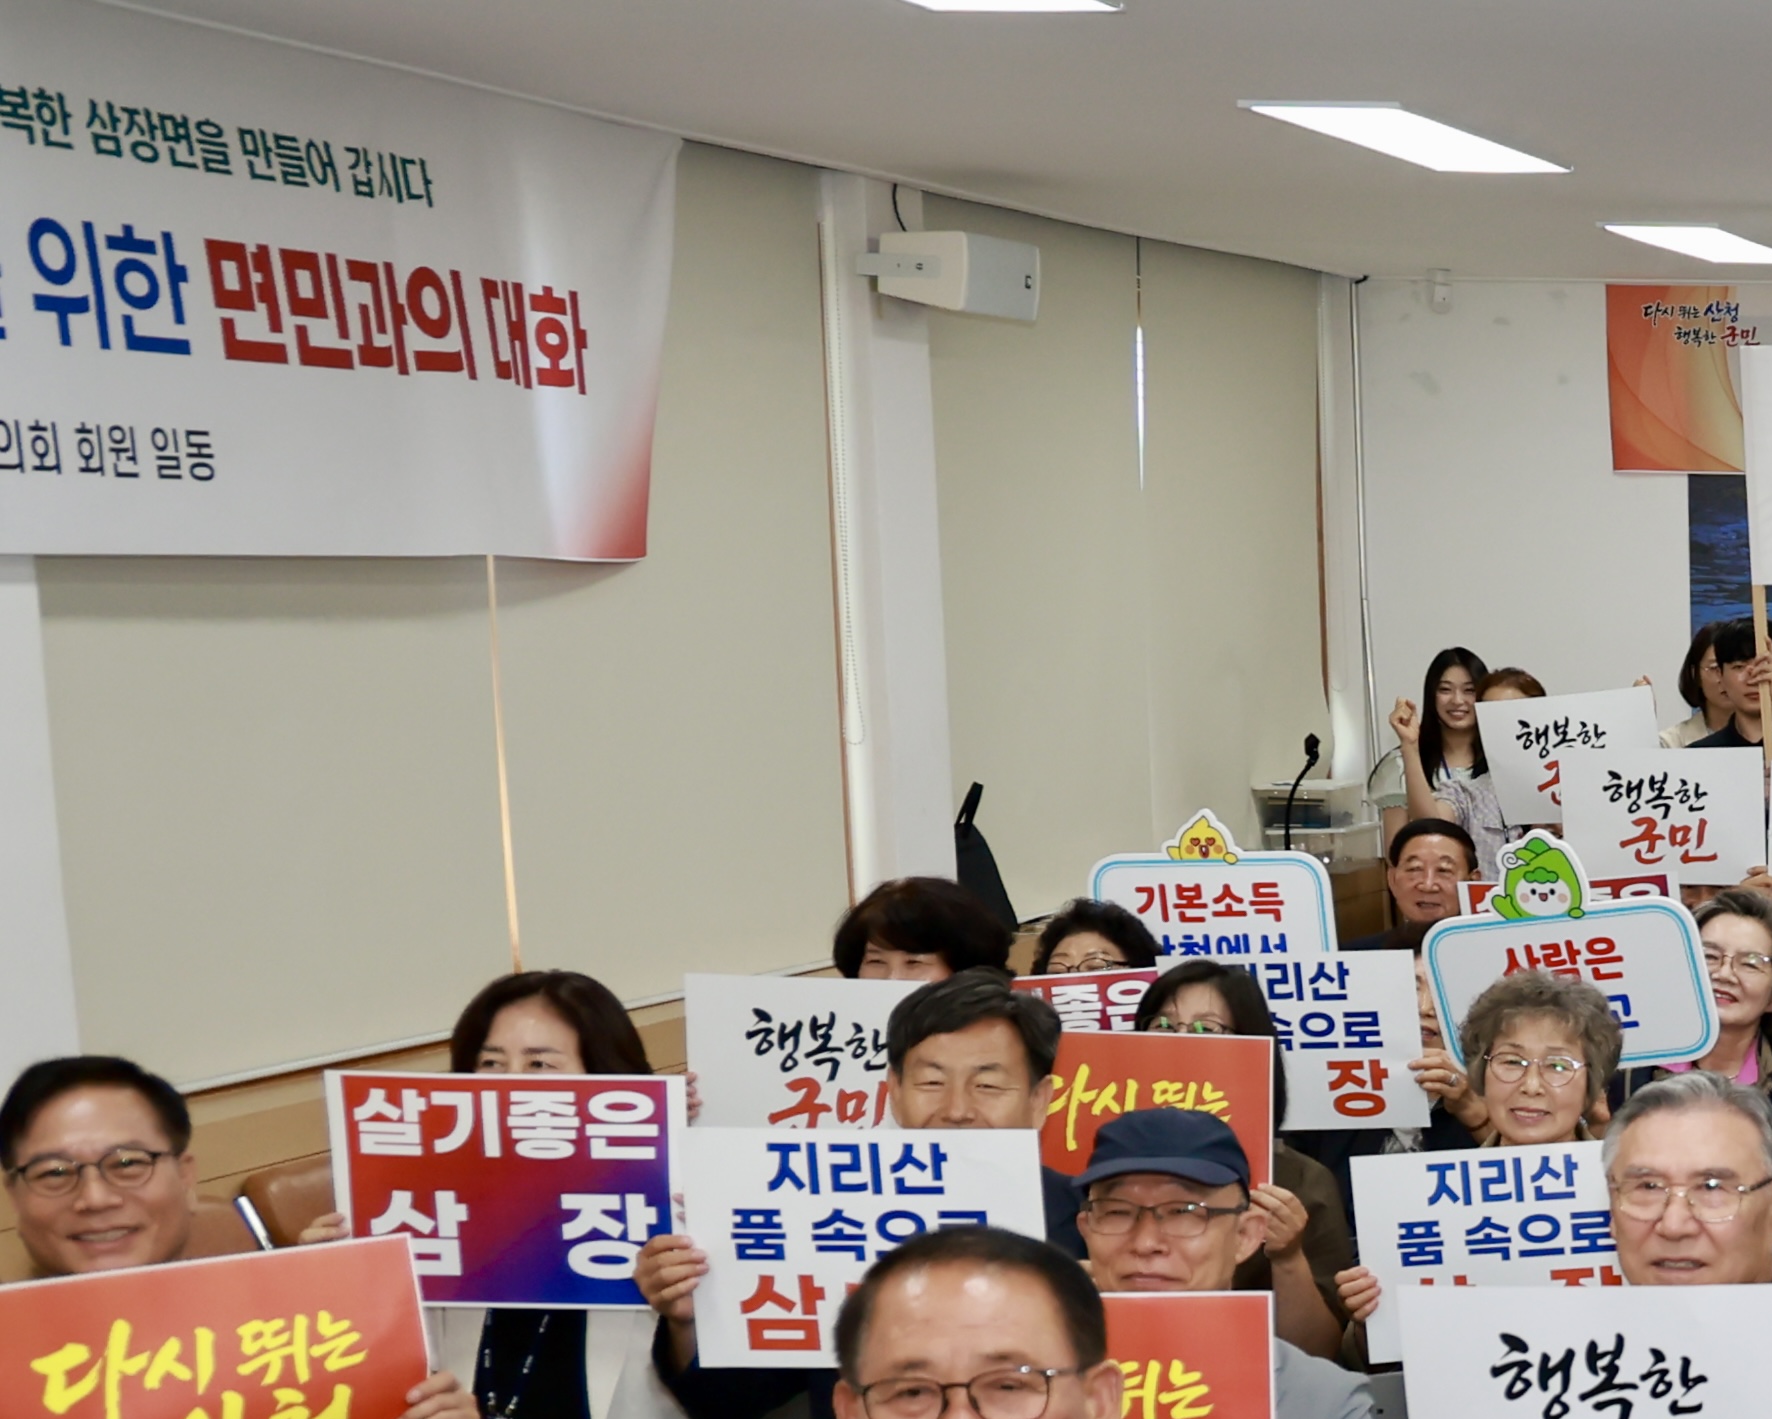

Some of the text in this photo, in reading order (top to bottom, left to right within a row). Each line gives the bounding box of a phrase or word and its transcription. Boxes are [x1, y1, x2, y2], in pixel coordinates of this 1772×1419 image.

[0, 84, 433, 207] 복한 삼장면을 만들어 갑시다
[28, 217, 191, 356] 위한
[204, 238, 478, 380] 면민과의
[480, 277, 588, 395] 대화
[1642, 300, 1740, 327] 다시 뛰는 산청
[1674, 325, 1761, 347] 행복한 군민
[75, 421, 140, 479] 회원
[151, 426, 215, 482] 일동
[1515, 716, 1607, 759] 행복한
[1603, 770, 1709, 819] 행복한
[1619, 817, 1719, 865] 군민
[1134, 881, 1284, 923] 기본소득
[1503, 936, 1624, 982] 사람은
[1033, 978, 1148, 1031] 좋은
[745, 1007, 889, 1081] 행복한
[1047, 1063, 1137, 1151] 다시
[1327, 1060, 1389, 1117] 장
[353, 1088, 659, 1159] 살기좋은
[766, 1141, 948, 1196] 지리산
[1426, 1153, 1579, 1207] 지리산
[370, 1190, 658, 1280] 삼 장
[731, 1208, 785, 1261] 품
[1397, 1210, 1618, 1267] 품 속으로
[740, 1275, 825, 1351] 삼
[236, 1310, 369, 1386] 뛰는
